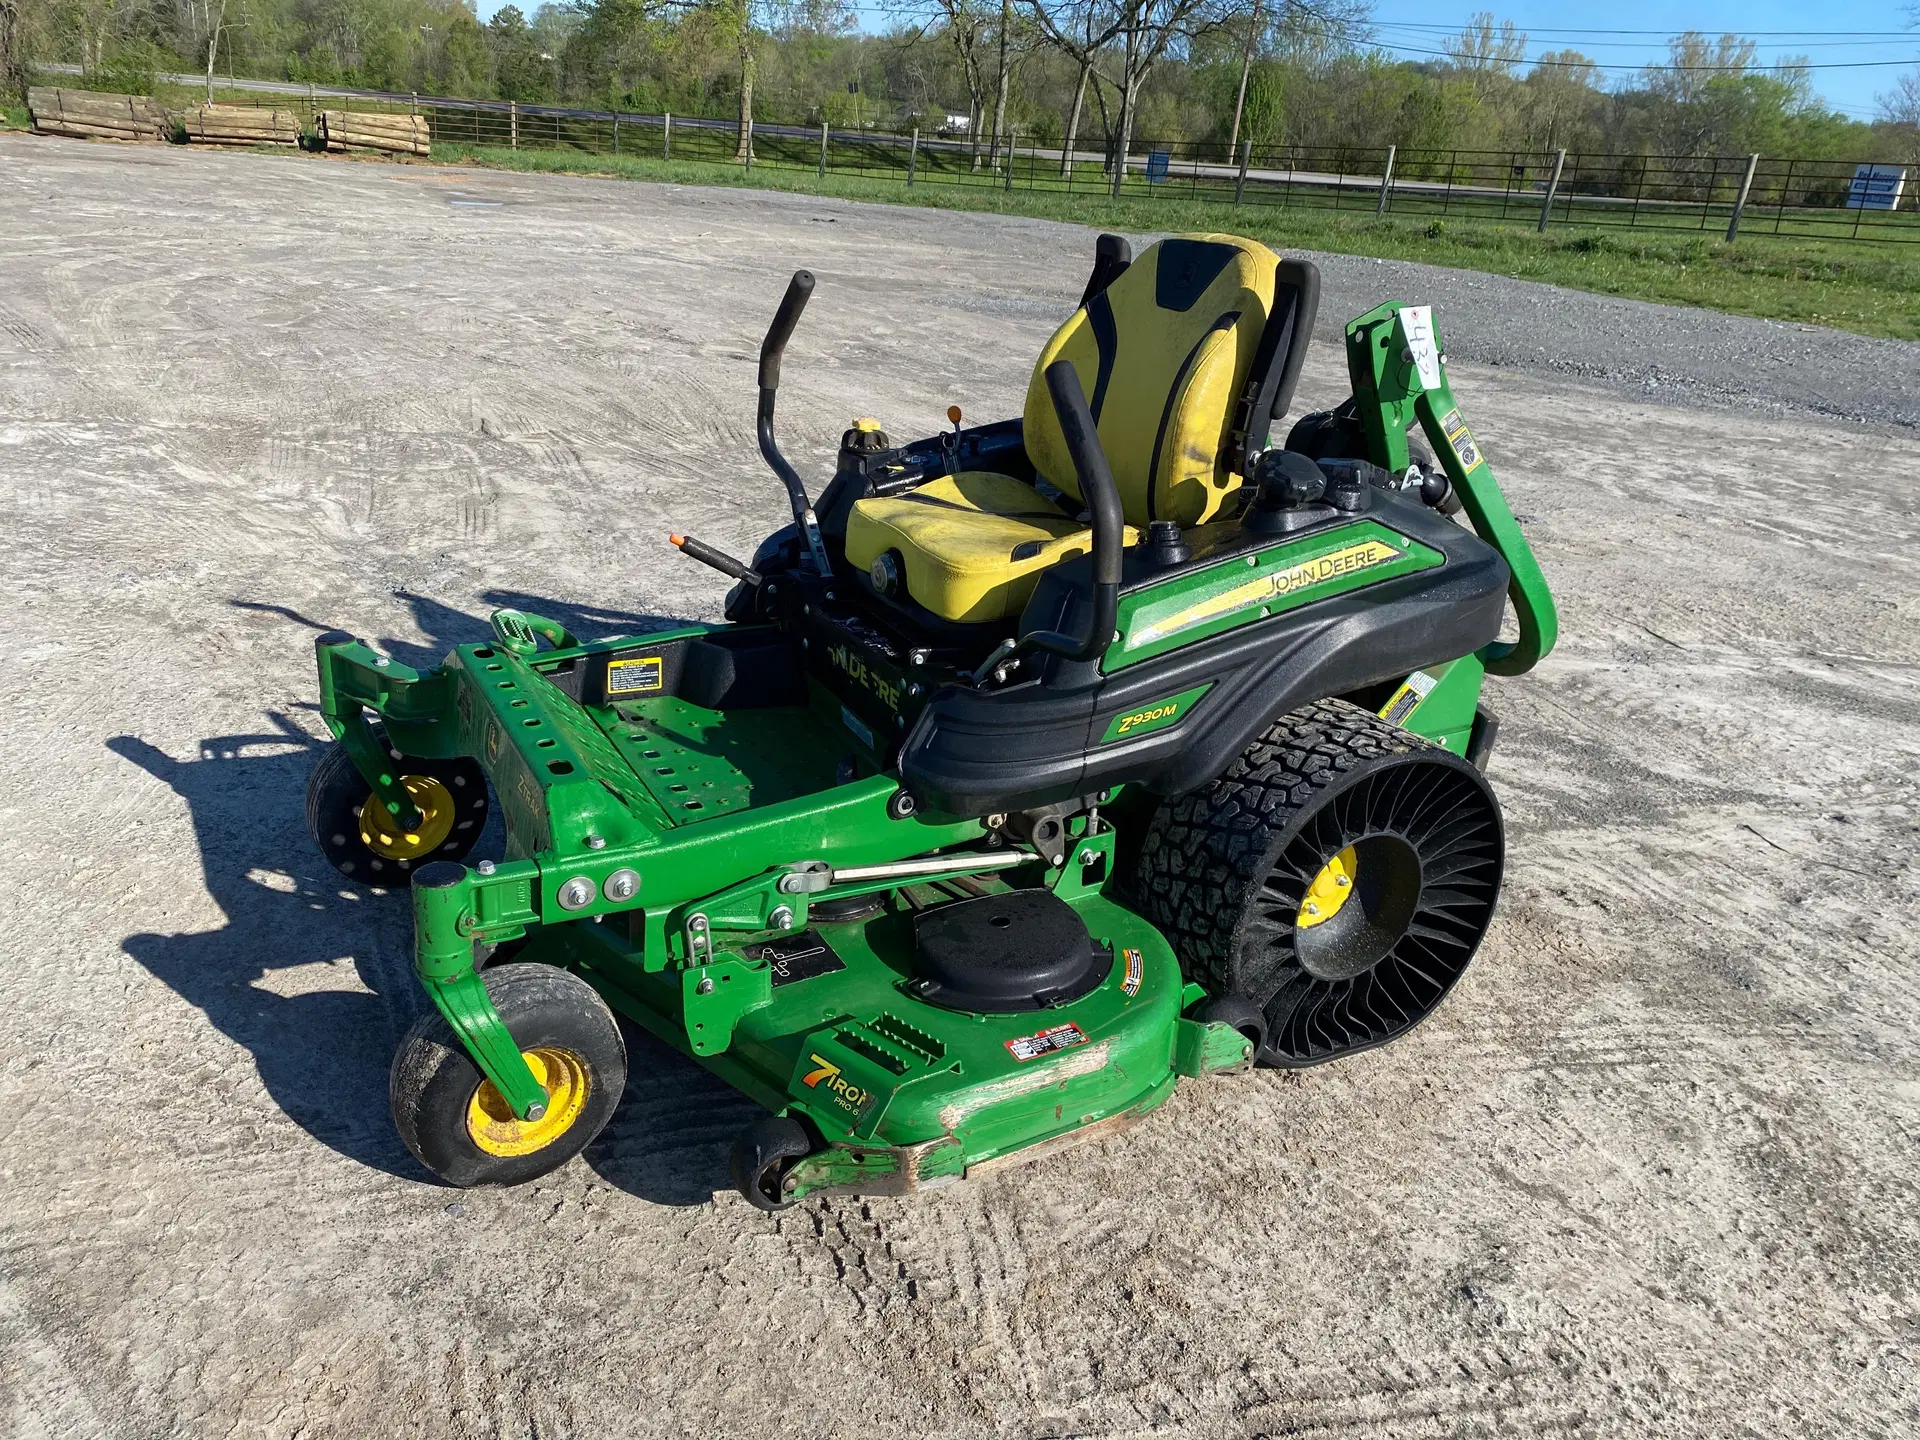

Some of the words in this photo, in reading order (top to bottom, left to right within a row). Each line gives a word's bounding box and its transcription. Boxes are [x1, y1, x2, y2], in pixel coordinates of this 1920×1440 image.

[1266, 567, 1315, 595] JOHN
[1319, 548, 1377, 577] DEERE
[1118, 703, 1178, 733] Z930M
[834, 1096, 852, 1111] PRO
